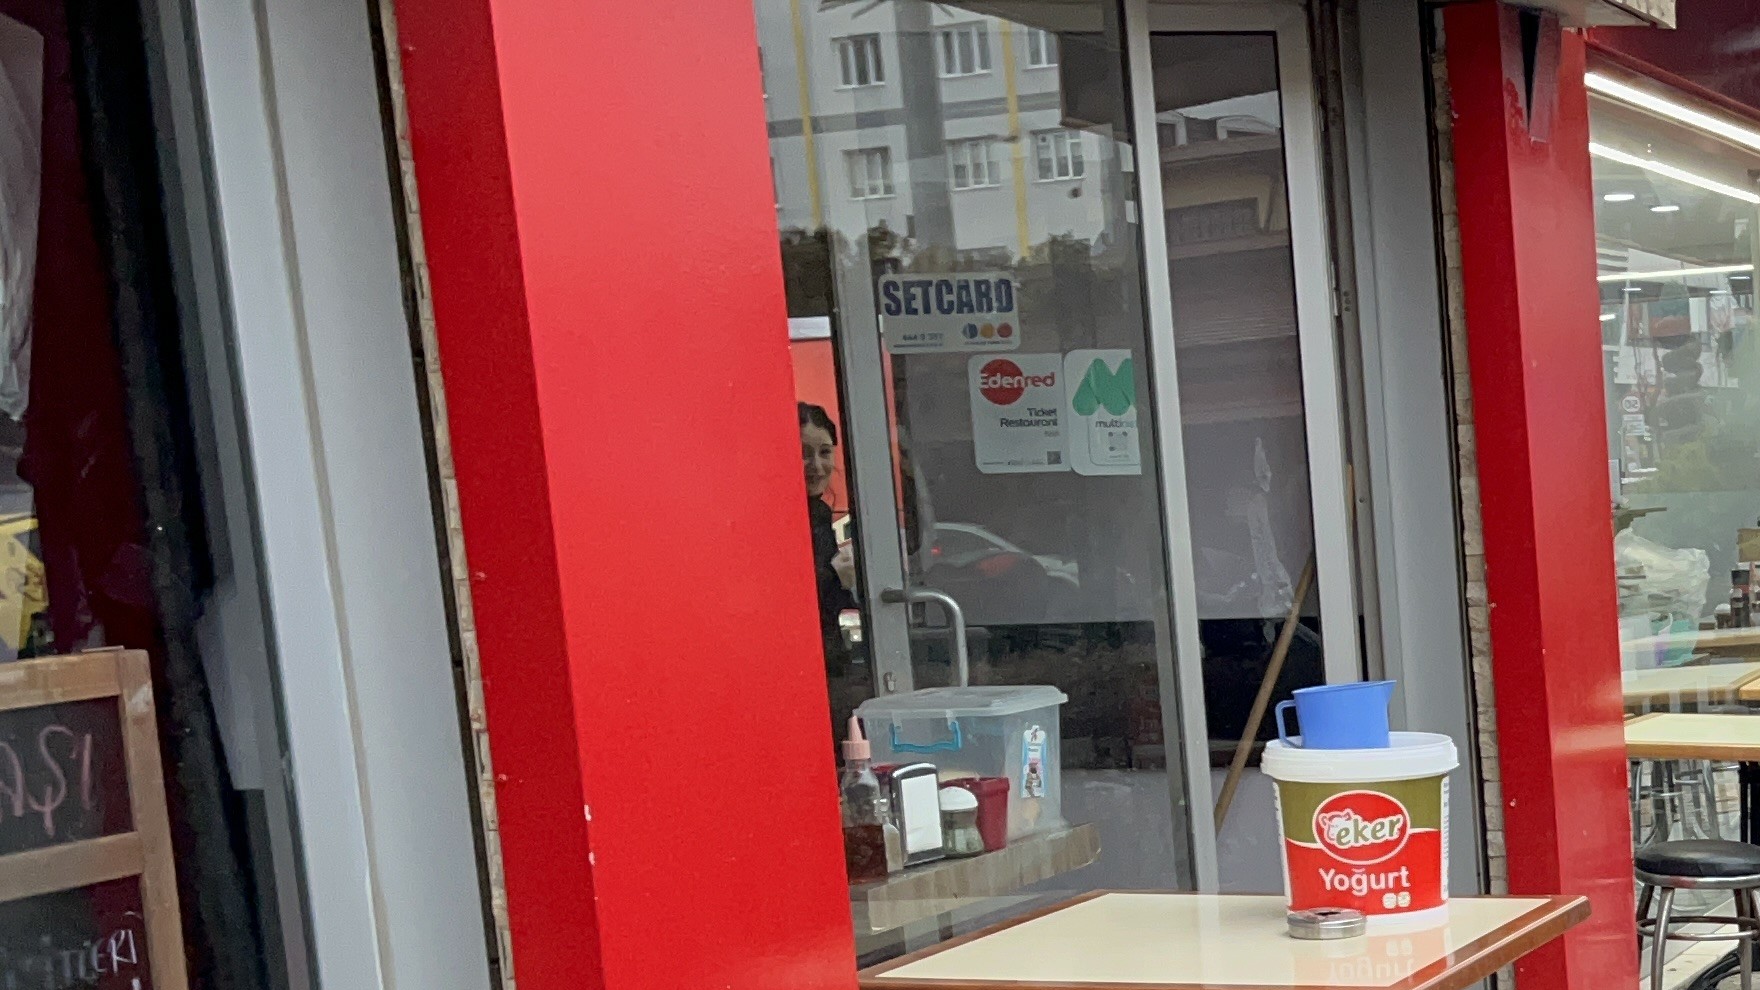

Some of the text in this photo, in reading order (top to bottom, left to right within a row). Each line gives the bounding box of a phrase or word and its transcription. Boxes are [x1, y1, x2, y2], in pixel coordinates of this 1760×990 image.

[882, 278, 1014, 316] SETCARD
[979, 371, 1056, 389] Edenred
[1027, 407, 1058, 418] Ticket
[1318, 865, 1412, 896] Yoğurt
